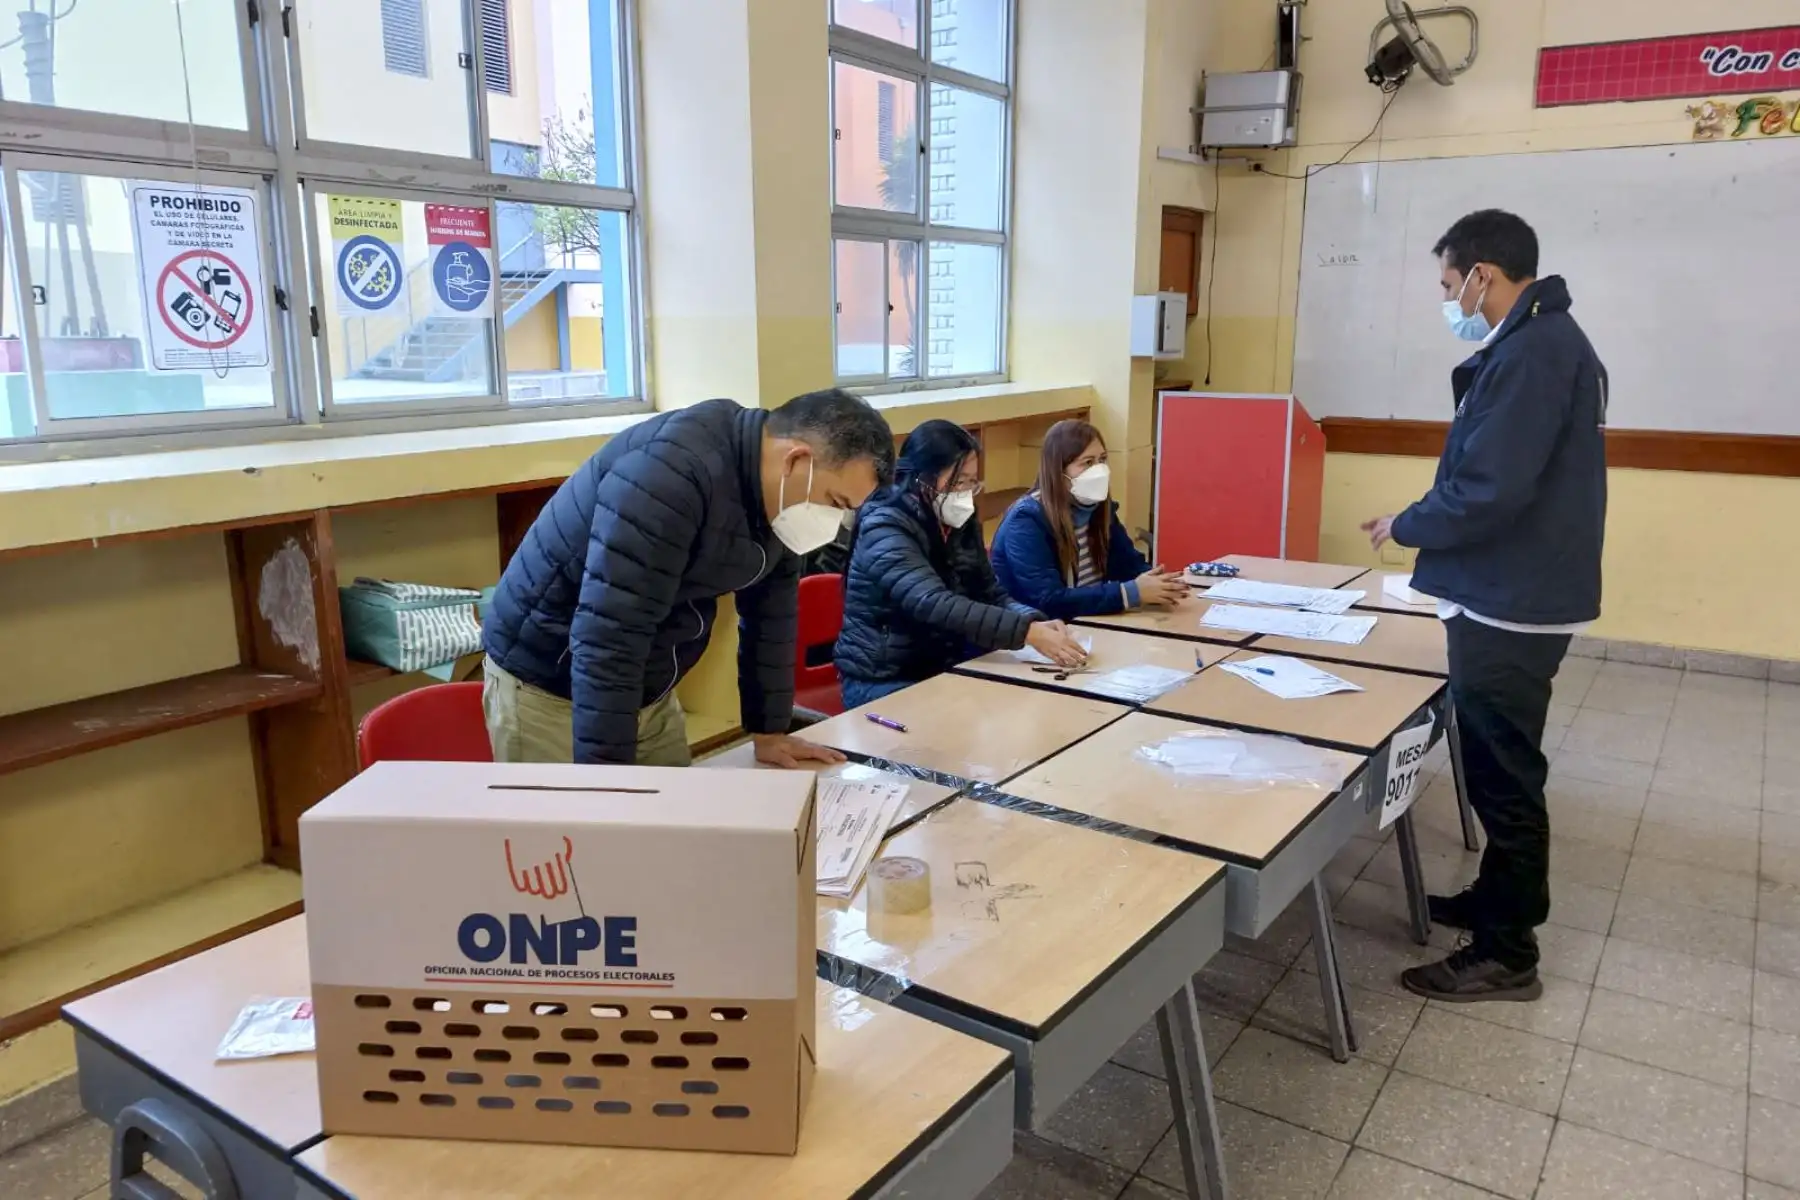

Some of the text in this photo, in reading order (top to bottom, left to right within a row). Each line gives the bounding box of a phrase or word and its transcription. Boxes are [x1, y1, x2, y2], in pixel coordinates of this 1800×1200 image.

[1702, 47, 1800, 74] "Con c
[150, 195, 241, 213] PROHIBIDO
[333, 216, 399, 230] DESINFECTADA
[1385, 766, 1421, 807] 901
[457, 912, 638, 967] ONPE
[424, 965, 675, 982] OFICINA NACIONAL DE PROCESOS ELECTORALES
